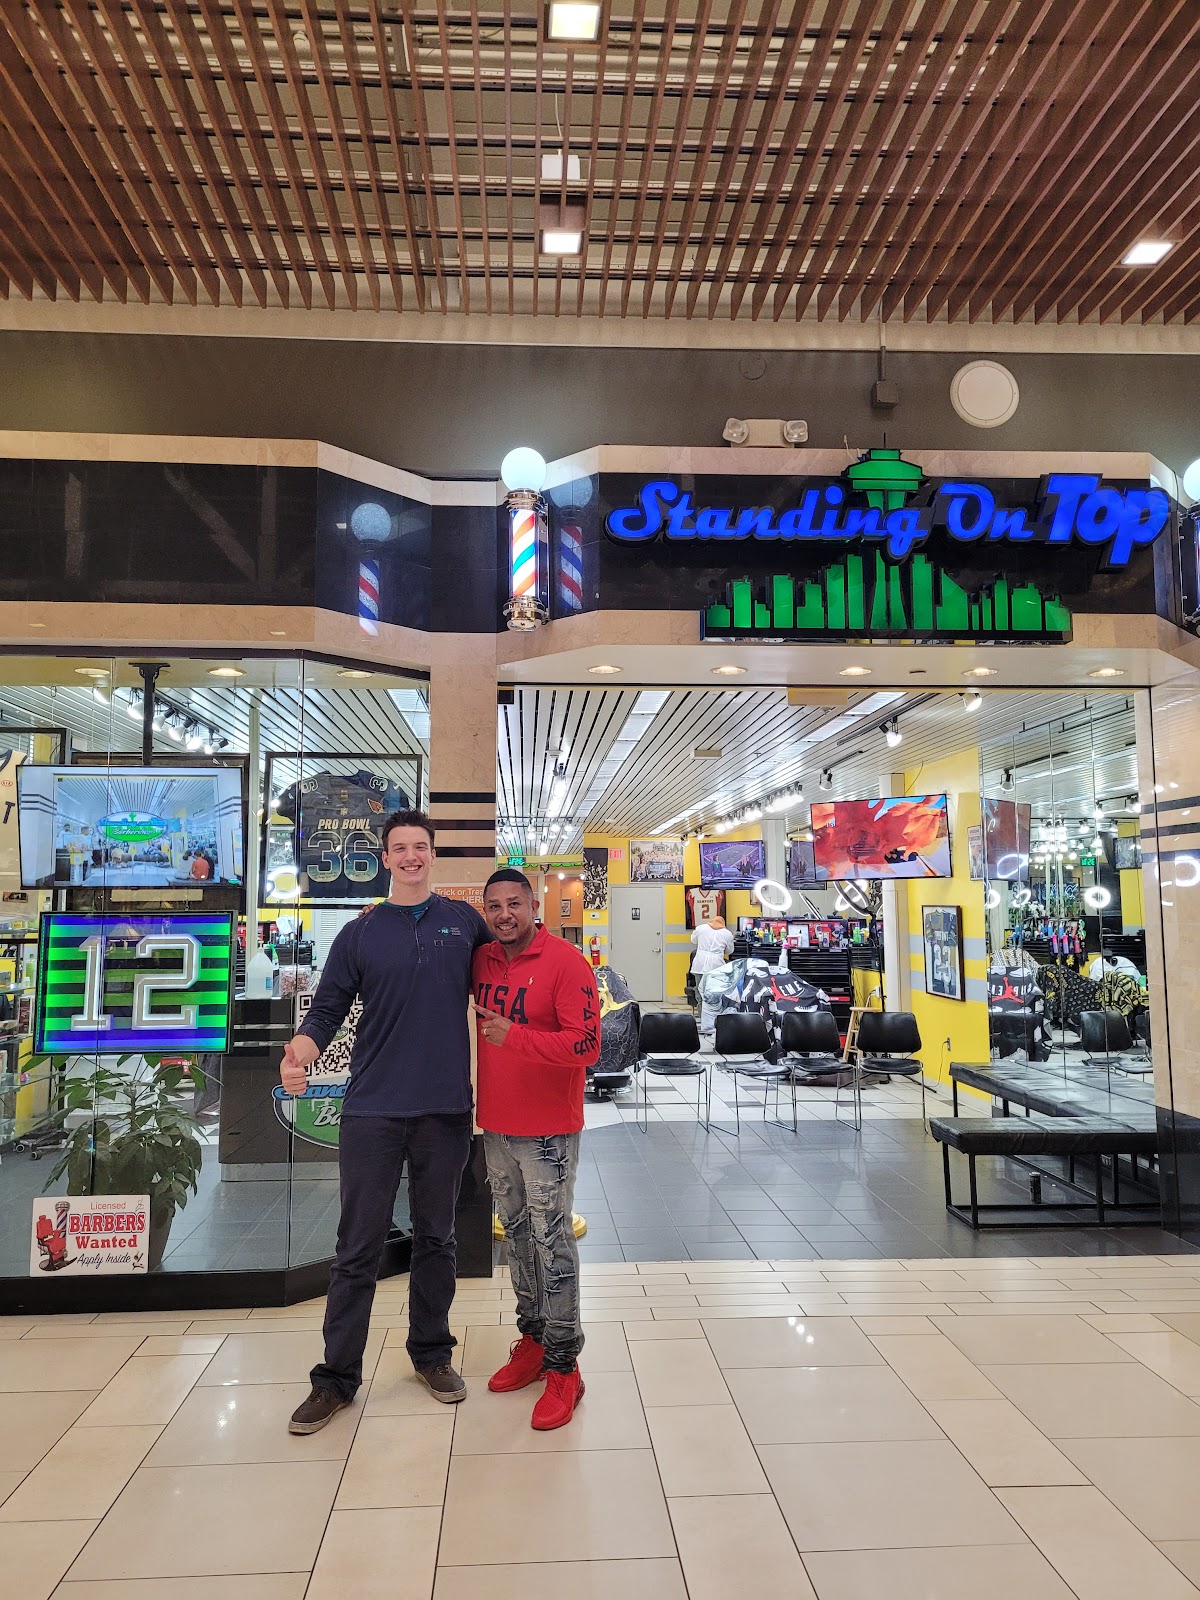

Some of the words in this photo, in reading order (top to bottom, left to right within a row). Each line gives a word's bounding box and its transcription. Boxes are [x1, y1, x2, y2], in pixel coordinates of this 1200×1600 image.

[606, 480, 929, 558] Standing
[939, 483, 1035, 539] On
[1049, 474, 1170, 565] Top
[317, 818, 339, 830] PRO
[341, 818, 371, 830] BOWL
[306, 830, 379, 883] 36
[609, 849, 622, 859] EXIT
[436, 888, 456, 896] Trick
[468, 888, 485, 896] Trea
[701, 904, 710, 919] 2
[70, 933, 203, 1031] 12
[476, 982, 529, 1025] USA
[90, 1201, 127, 1211] Licensed
[69, 1213, 146, 1234] BARBERS
[75, 1235, 138, 1249] Wanted
[77, 1253, 104, 1269] Apply
[105, 1252, 132, 1264] Inside
